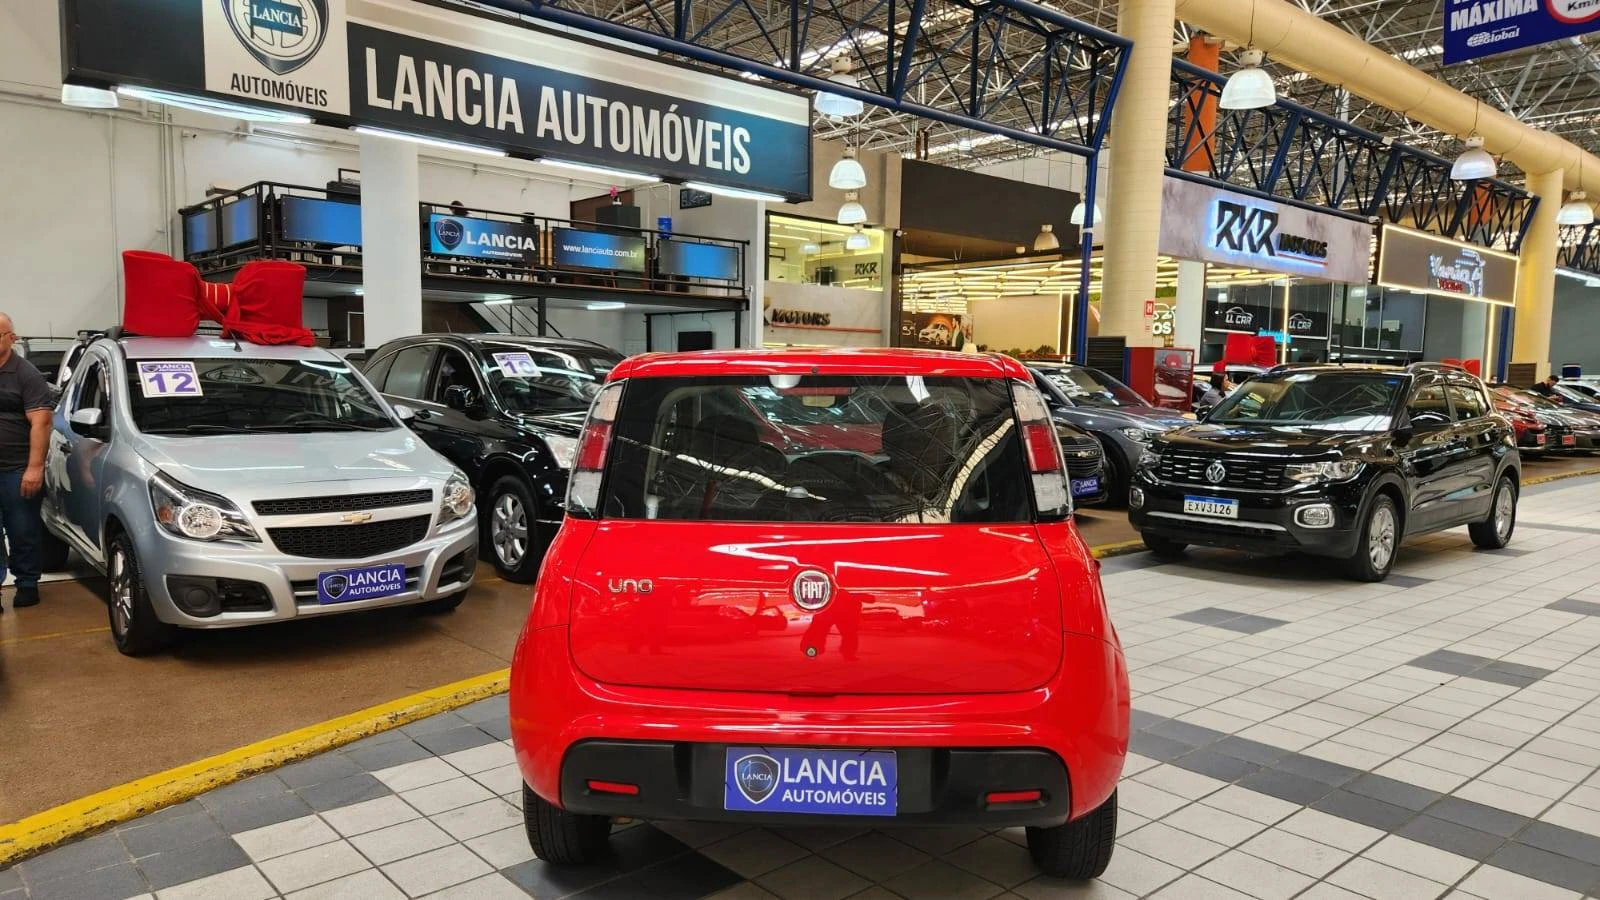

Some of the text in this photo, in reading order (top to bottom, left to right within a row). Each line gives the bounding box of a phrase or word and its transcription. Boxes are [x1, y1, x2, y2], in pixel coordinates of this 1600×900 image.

[252, 5, 301, 27] LANCIA
[1450, 0, 1539, 32] MÁXIMA
[230, 73, 328, 107] AUTOMÓVEIS
[365, 47, 752, 175] LANCIA AUTOMÓVEIS
[1215, 199, 1279, 257] RKR
[466, 230, 536, 251] LANCIA
[148, 372, 197, 393] 12
[349, 568, 401, 587] LANCIA
[349, 582, 401, 596] AUTOMÓVEIS
[801, 581, 825, 599] FIAT
[742, 771, 773, 782] LANCIA
[783, 757, 888, 787] LANCIA
[781, 788, 887, 806] AUTOMÓVEIS
